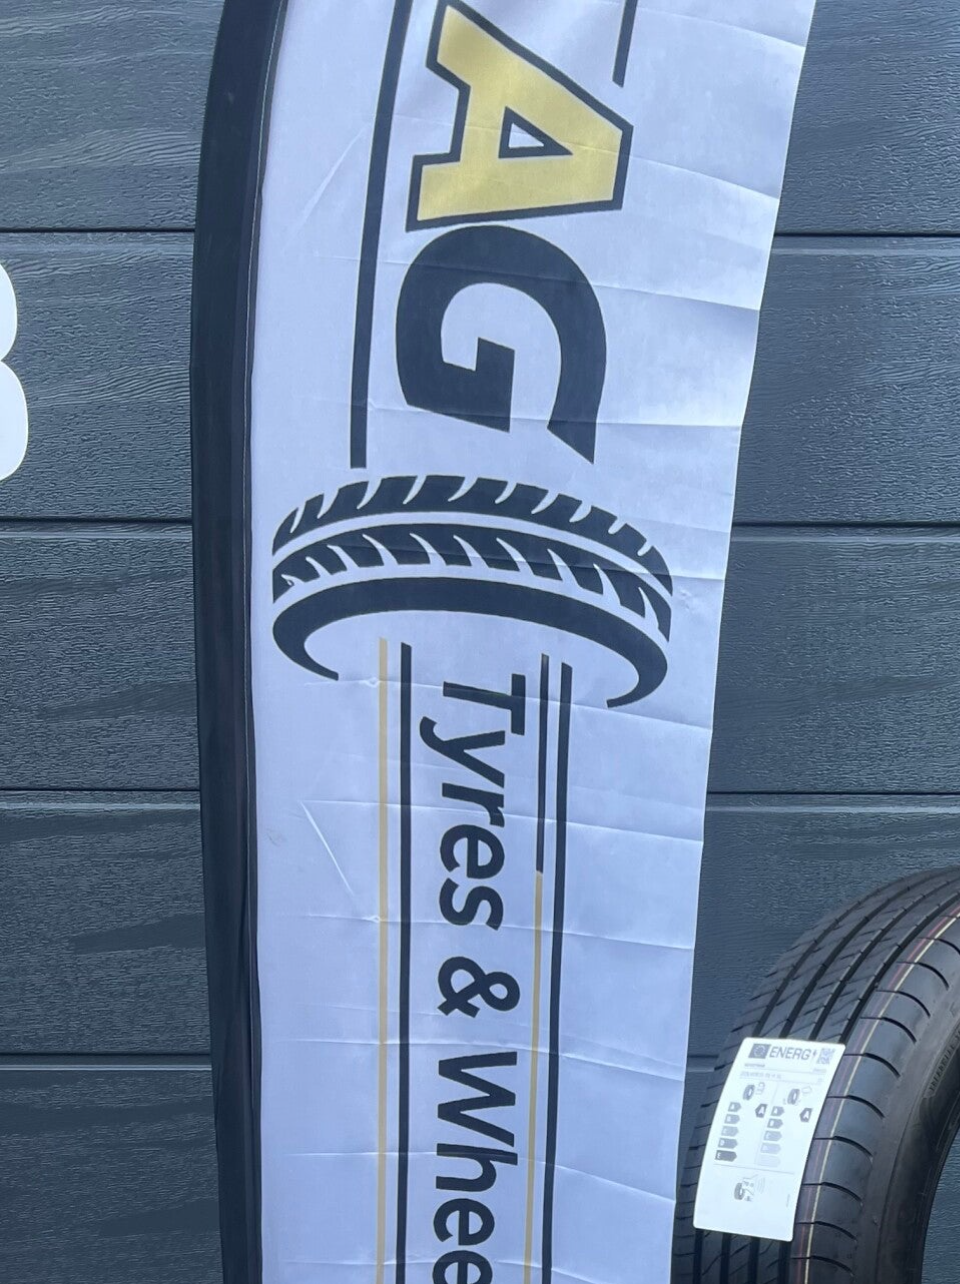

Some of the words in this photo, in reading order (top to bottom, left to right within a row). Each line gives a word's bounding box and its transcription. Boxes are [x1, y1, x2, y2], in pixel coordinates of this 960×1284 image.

[420, 673, 526, 931] Tyres
[437, 956, 520, 1019] &
[769, 1047, 810, 1060] ENERG
